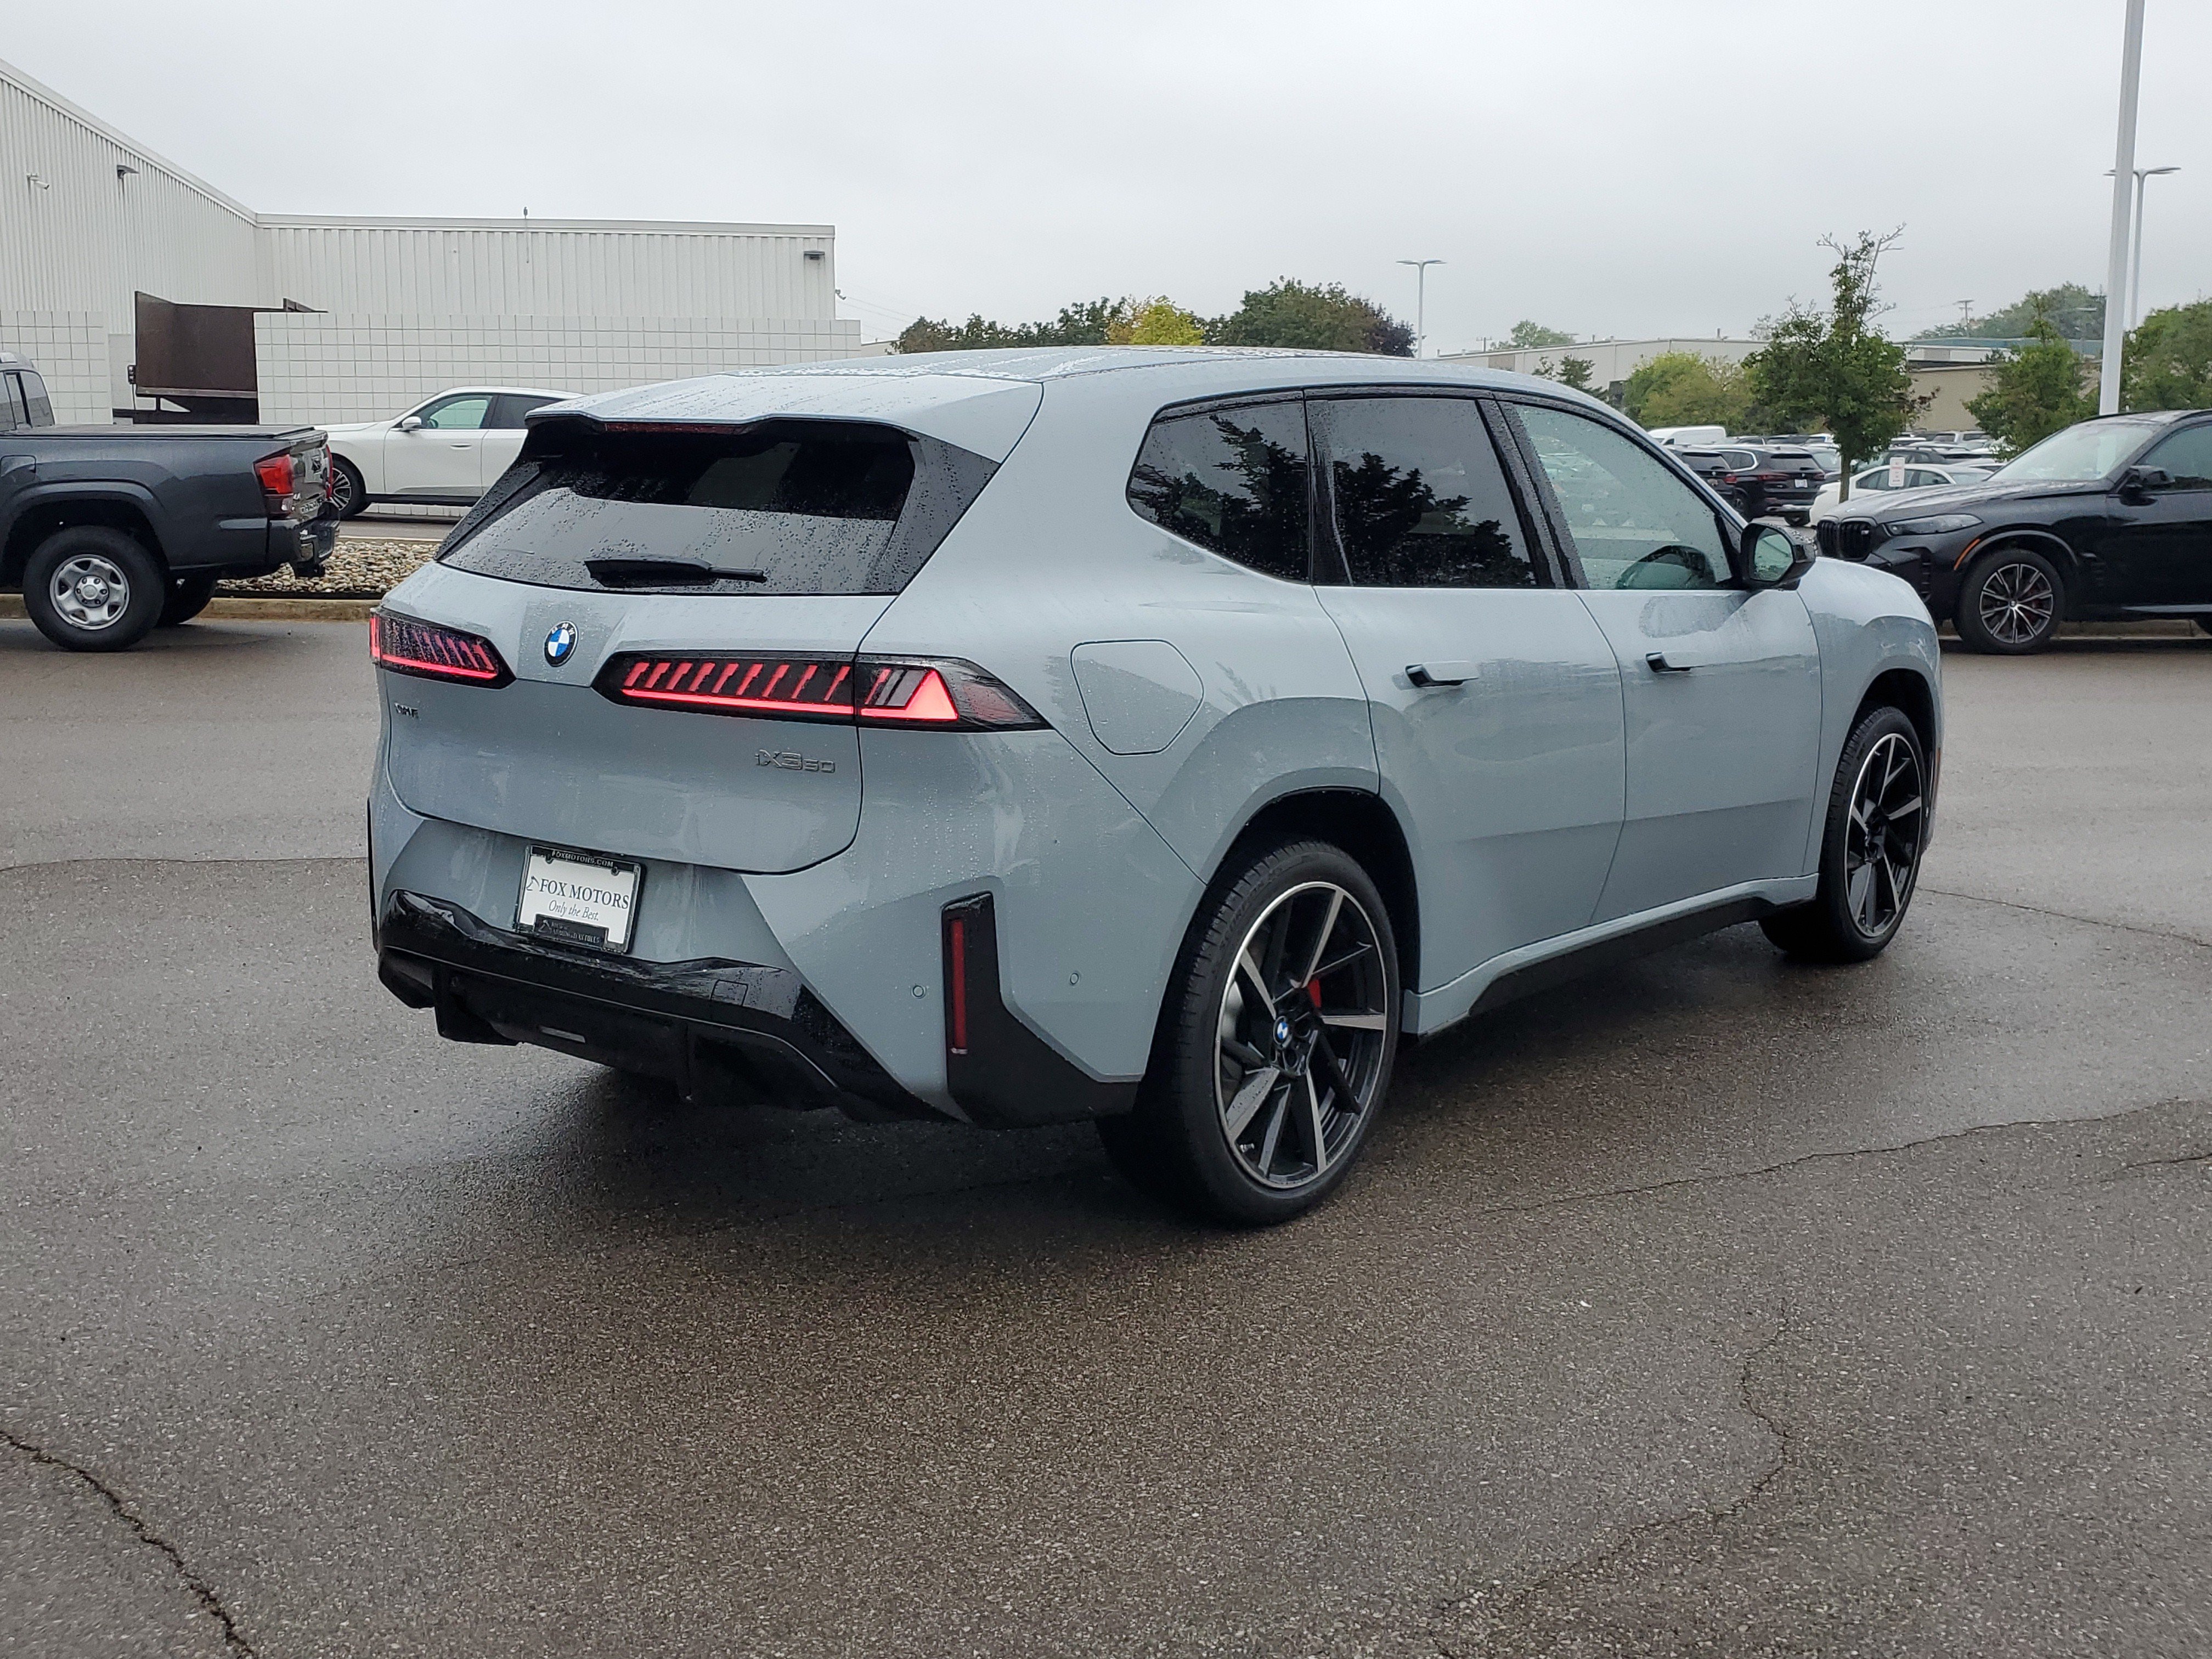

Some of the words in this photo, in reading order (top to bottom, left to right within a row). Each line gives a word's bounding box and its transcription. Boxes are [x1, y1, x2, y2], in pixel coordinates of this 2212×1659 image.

[551, 623, 575, 636] BMW
[539, 878, 567, 897] FOX
[569, 884, 629, 909] MOTORS
[549, 900, 567, 917] Only
[568, 904, 580, 917] the
[582, 906, 599, 921] Best.
